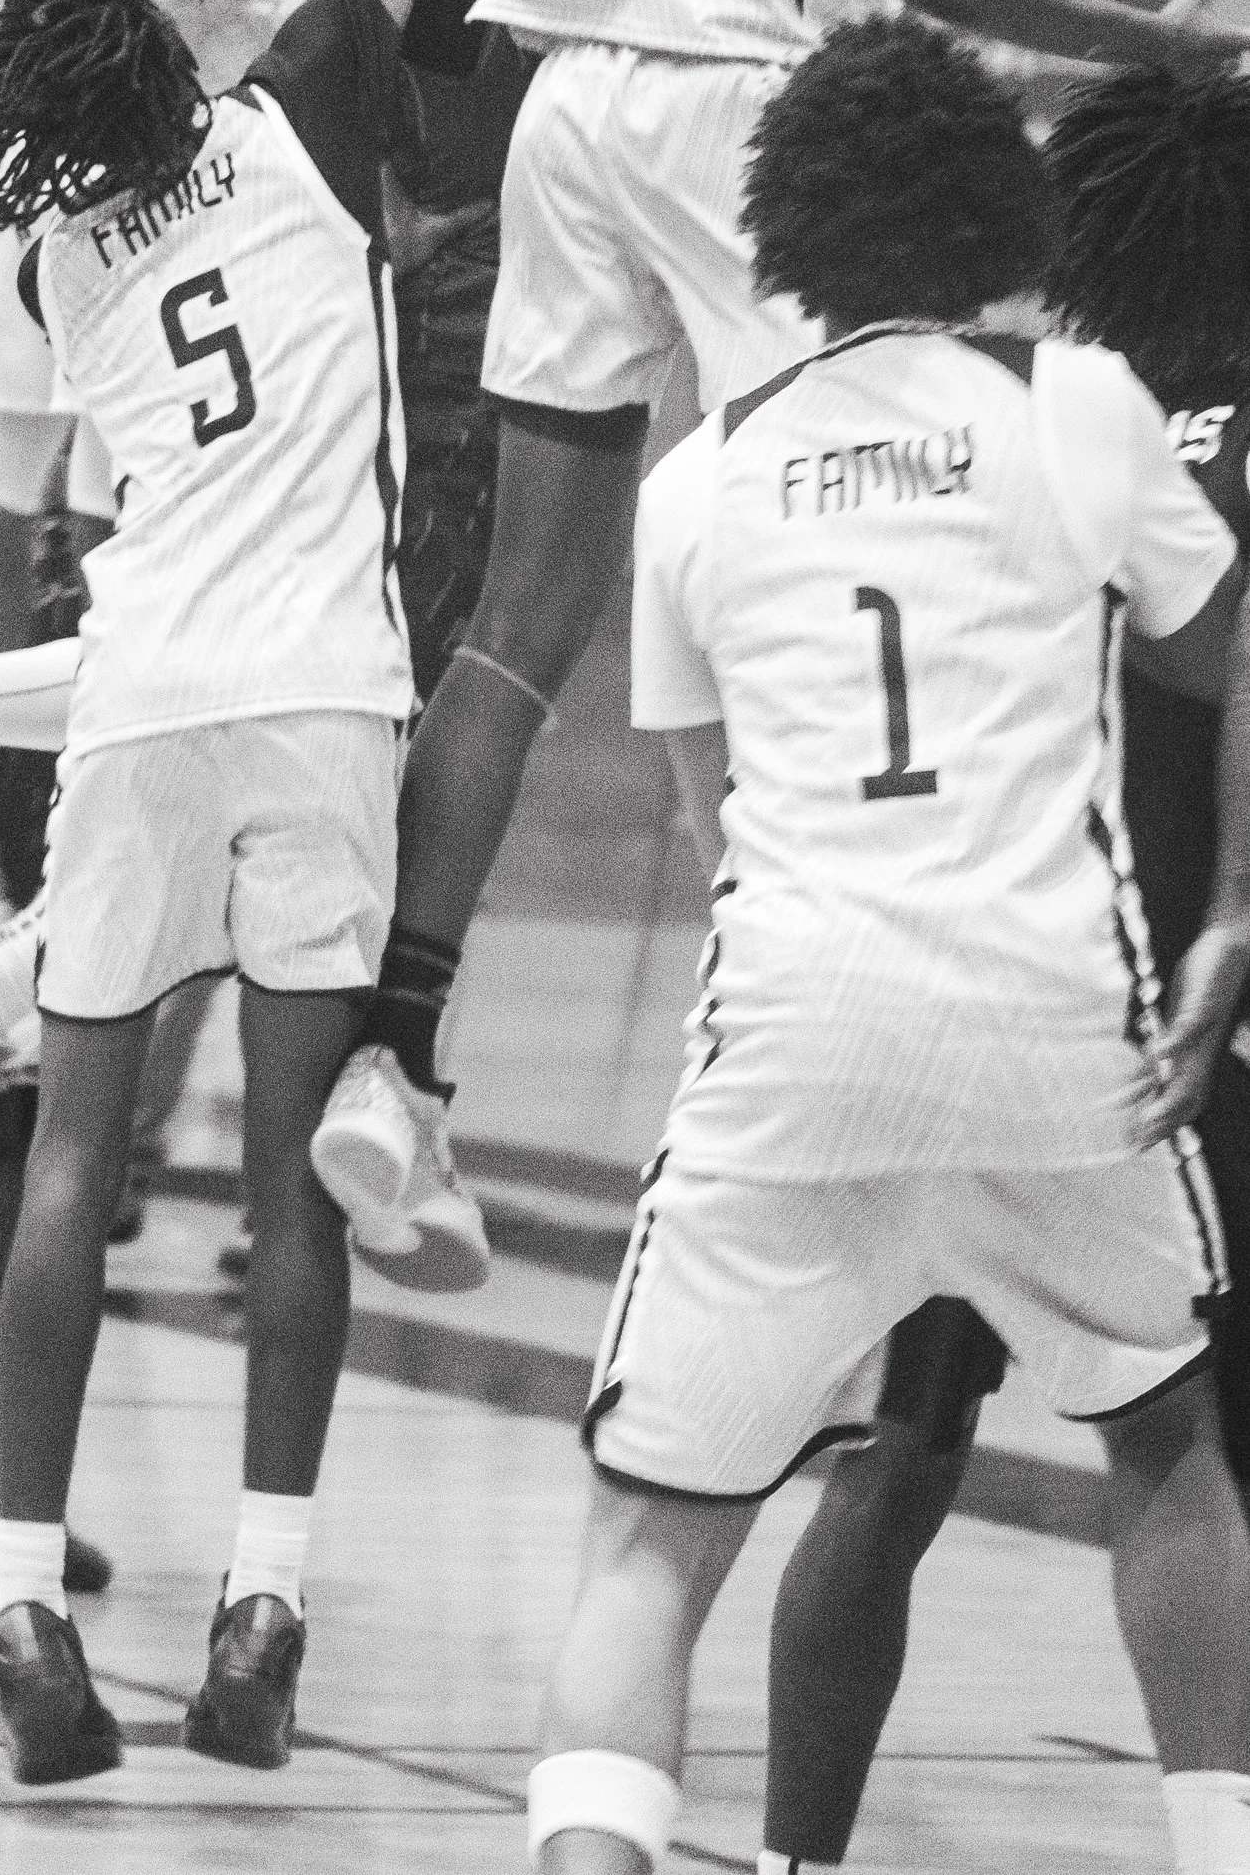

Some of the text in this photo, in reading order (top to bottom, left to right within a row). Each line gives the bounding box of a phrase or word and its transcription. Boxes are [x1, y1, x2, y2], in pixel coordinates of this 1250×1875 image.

[90, 151, 239, 270] FAMILY
[160, 266, 258, 449] 5
[781, 423, 975, 522] FAMILY
[854, 585, 939, 802] 1
